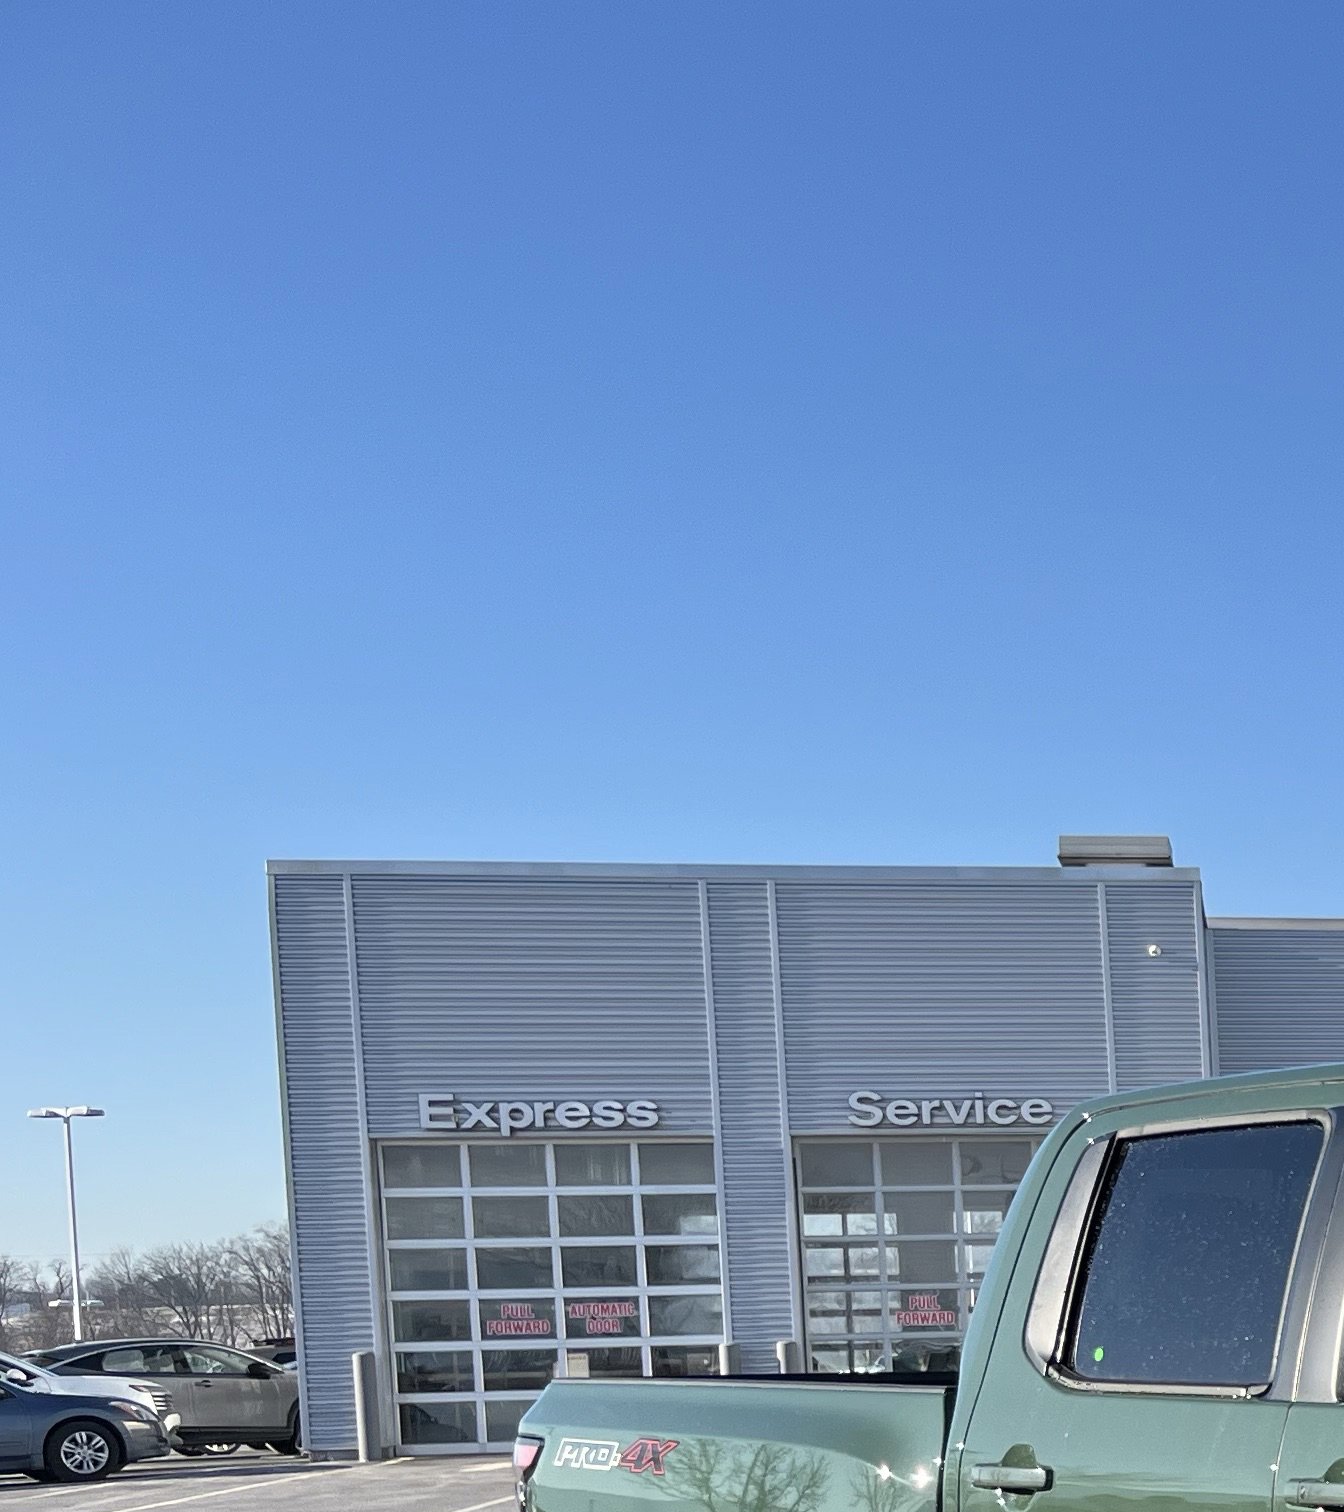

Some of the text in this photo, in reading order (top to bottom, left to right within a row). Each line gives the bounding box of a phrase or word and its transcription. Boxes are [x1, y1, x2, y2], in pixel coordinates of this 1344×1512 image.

[418, 1092, 660, 1137] Express
[848, 1090, 1054, 1127] Service
[569, 1302, 636, 1318] AUTOMATIC
[909, 1296, 941, 1310] PULL
[501, 1303, 535, 1319] PULL
[896, 1311, 956, 1326] FORWARD
[487, 1320, 550, 1335] FORWARD
[586, 1319, 622, 1334] DOOR
